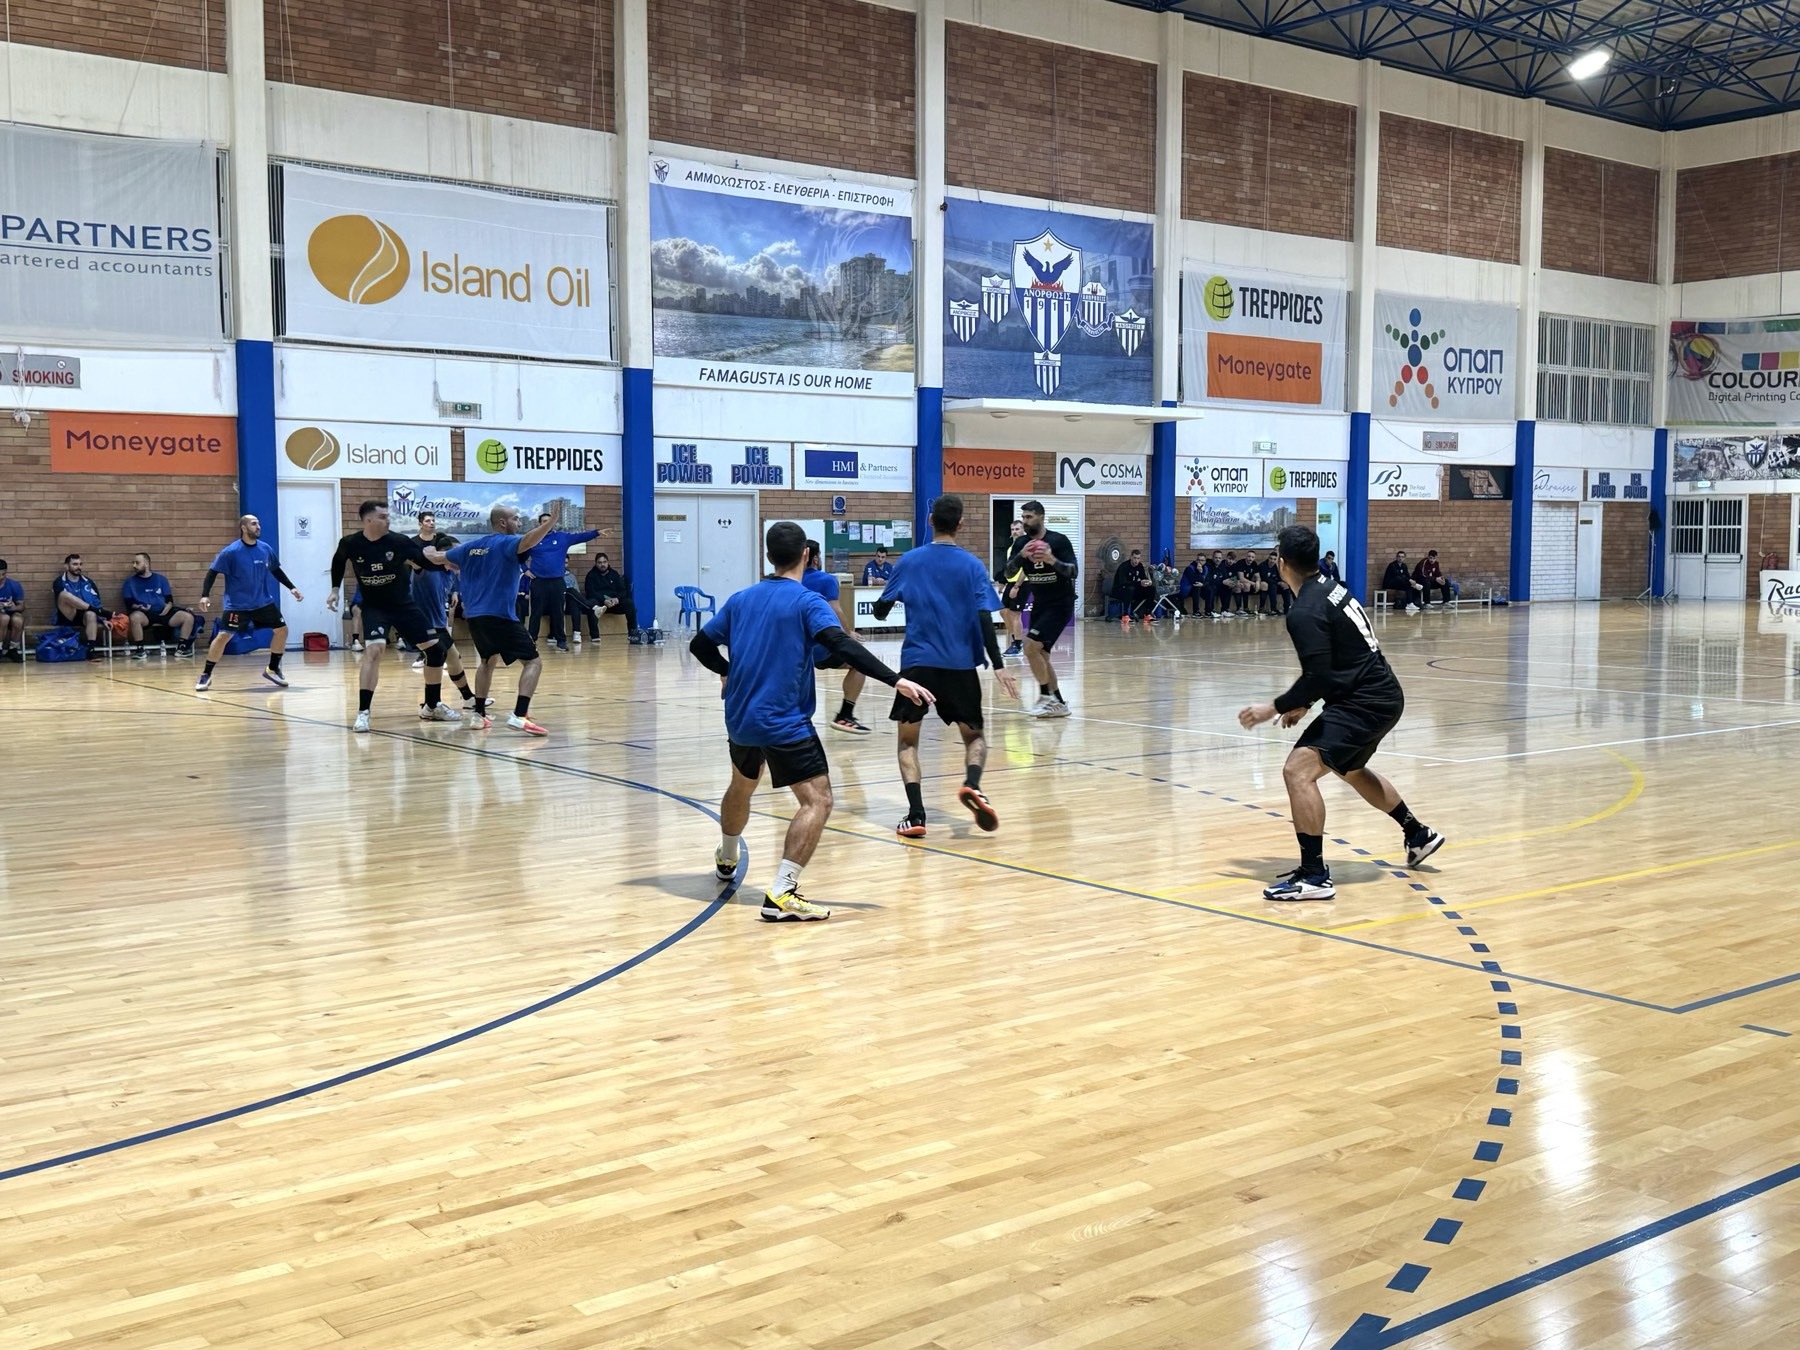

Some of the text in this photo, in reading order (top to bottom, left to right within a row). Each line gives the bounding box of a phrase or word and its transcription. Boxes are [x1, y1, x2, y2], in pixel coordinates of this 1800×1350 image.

[685, 170, 766, 191] ΑΜΜΟΧΩΣΤΟΣ
[773, 182, 830, 199] ΕΛΕΥΘΕΡΙΑ
[837, 190, 894, 207] ΕΠΙΣΤΡΟΦΗ
[1, 214, 212, 252] PARTNERS
[88, 260, 212, 277] accountants
[422, 250, 590, 307] Island Oil
[1023, 289, 1071, 300] ΑΝΟΡΘΩΣΙΣ
[1239, 286, 1323, 325] TREPPIDES
[12, 369, 75, 385] SMOKING
[1218, 353, 1311, 381] Moneygate
[699, 367, 873, 390] FAMAGUSTA IS OUR HOME
[1447, 376, 1503, 395] ΚΥΠΡΟΥ
[1708, 371, 1800, 389] COLOUR
[1708, 391, 1742, 404] Digital
[1744, 390, 1786, 404] Printing
[66, 429, 222, 456] Moneygate
[346, 443, 439, 466] Island Oil
[512, 446, 603, 472] TREPPIDES
[671, 443, 698, 464] ICE
[744, 445, 770, 466] ICE
[656, 462, 713, 484] POWER
[730, 463, 784, 485] POWER
[832, 460, 898, 472] HMI & Partners
[943, 461, 1026, 480] Moneygate
[1100, 463, 1143, 478] COSMA
[1213, 483, 1249, 493] ΚΥΠΡΟΥ
[1289, 470, 1338, 489] TREPPIDES
[1387, 483, 1408, 497] SSP
[370, 562, 384, 571] 26
